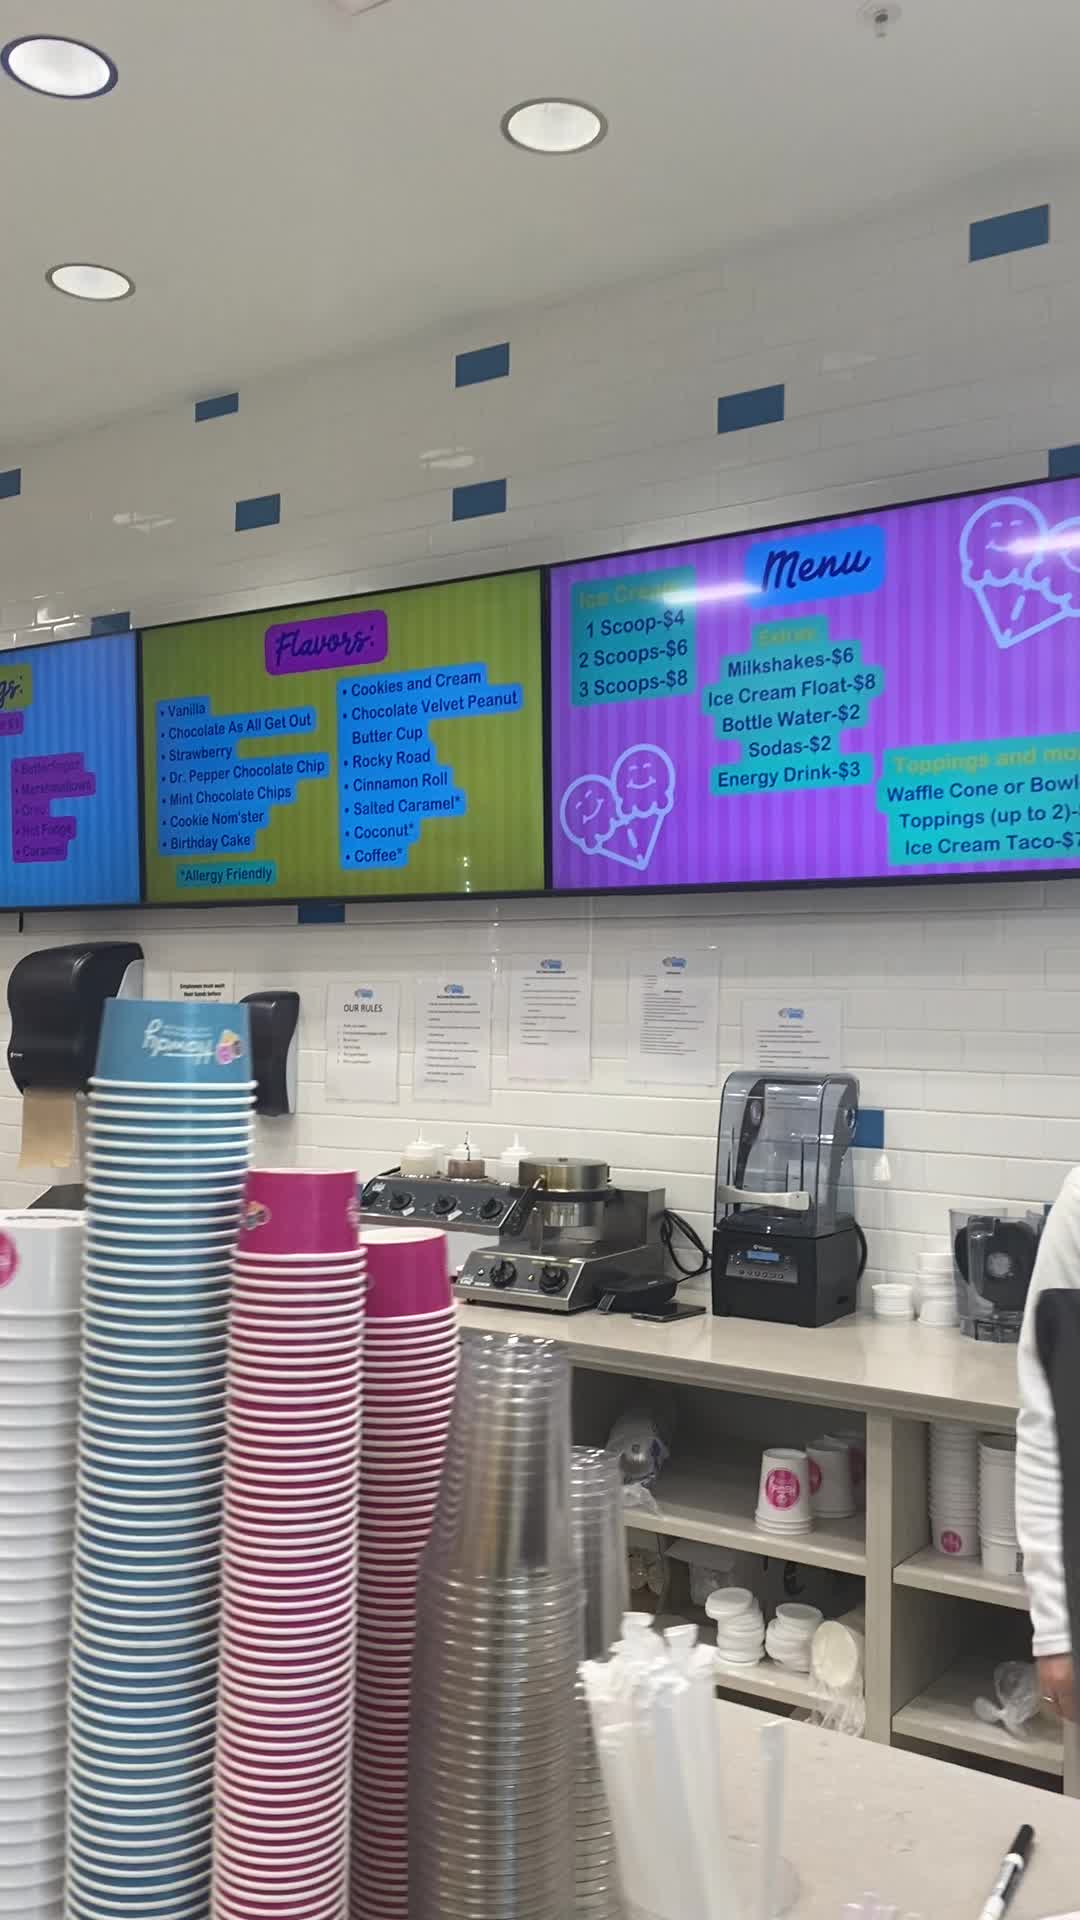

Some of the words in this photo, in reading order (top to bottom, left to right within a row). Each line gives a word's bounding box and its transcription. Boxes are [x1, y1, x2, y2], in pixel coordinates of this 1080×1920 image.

[761, 550, 872, 592] Menu
[586, 622, 593, 638] 1
[600, 609, 685, 636] Scoop-$4
[276, 625, 374, 666] Flavors:
[579, 652, 589, 668] 2
[594, 639, 688, 666] Scoops-$6
[728, 647, 854, 678] Milkshakes-$6
[351, 681, 403, 696] Cookies
[407, 675, 432, 690] and
[435, 672, 481, 687] Cream
[579, 681, 589, 697] 3
[594, 669, 688, 696] Scoops-$8
[708, 692, 734, 708] Ice
[738, 686, 796, 703] Cream
[802, 673, 876, 696] Float-$8
[168, 704, 206, 718] Vanilla
[352, 704, 417, 720] Chocolate
[421, 698, 464, 713] Velvet
[468, 690, 518, 708] Peanut
[169, 724, 225, 740] Chocolate
[228, 721, 243, 734] As
[247, 719, 261, 732] All
[265, 716, 286, 730] Get
[289, 713, 311, 727] Out
[722, 714, 773, 732] Bottle
[777, 704, 860, 727] Water-$2
[352, 730, 392, 744] Butter
[396, 727, 423, 742] Cup
[749, 735, 831, 758] Sodas-$2
[169, 746, 232, 762] Strawberry
[353, 753, 393, 769] Rocky
[397, 748, 431, 764] Road
[894, 754, 989, 775] Toppings
[997, 746, 1035, 767] and
[170, 772, 187, 784] Dr.
[189, 769, 230, 784] Pepper
[233, 762, 293, 778] Chocolate
[297, 760, 325, 774] Chip
[353, 778, 418, 792] Cinnamon
[422, 772, 448, 786] Roll
[718, 770, 778, 789] Energy
[784, 761, 860, 782] Drink-$3
[170, 793, 193, 806] Mint
[196, 789, 254, 804] Chocolate
[257, 786, 292, 801] Chips
[887, 784, 944, 803] Waffle
[950, 782, 998, 798] Cone
[1004, 782, 1025, 795] or
[170, 815, 208, 828] Cookie
[212, 811, 264, 825] Nom'ster
[354, 801, 394, 815] Salted
[899, 811, 985, 830] Toppings
[991, 809, 1021, 826] (up
[1027, 805, 1046, 821] to
[1052, 803, 1080, 823] 2)-
[171, 836, 218, 851] Birthday
[221, 834, 250, 847] Cake
[905, 840, 932, 855] Ice
[938, 839, 1000, 854] Cream
[226, 867, 273, 882] Friendly
[343, 1003, 360, 1013] OUR
[360, 1003, 383, 1013] RULES
